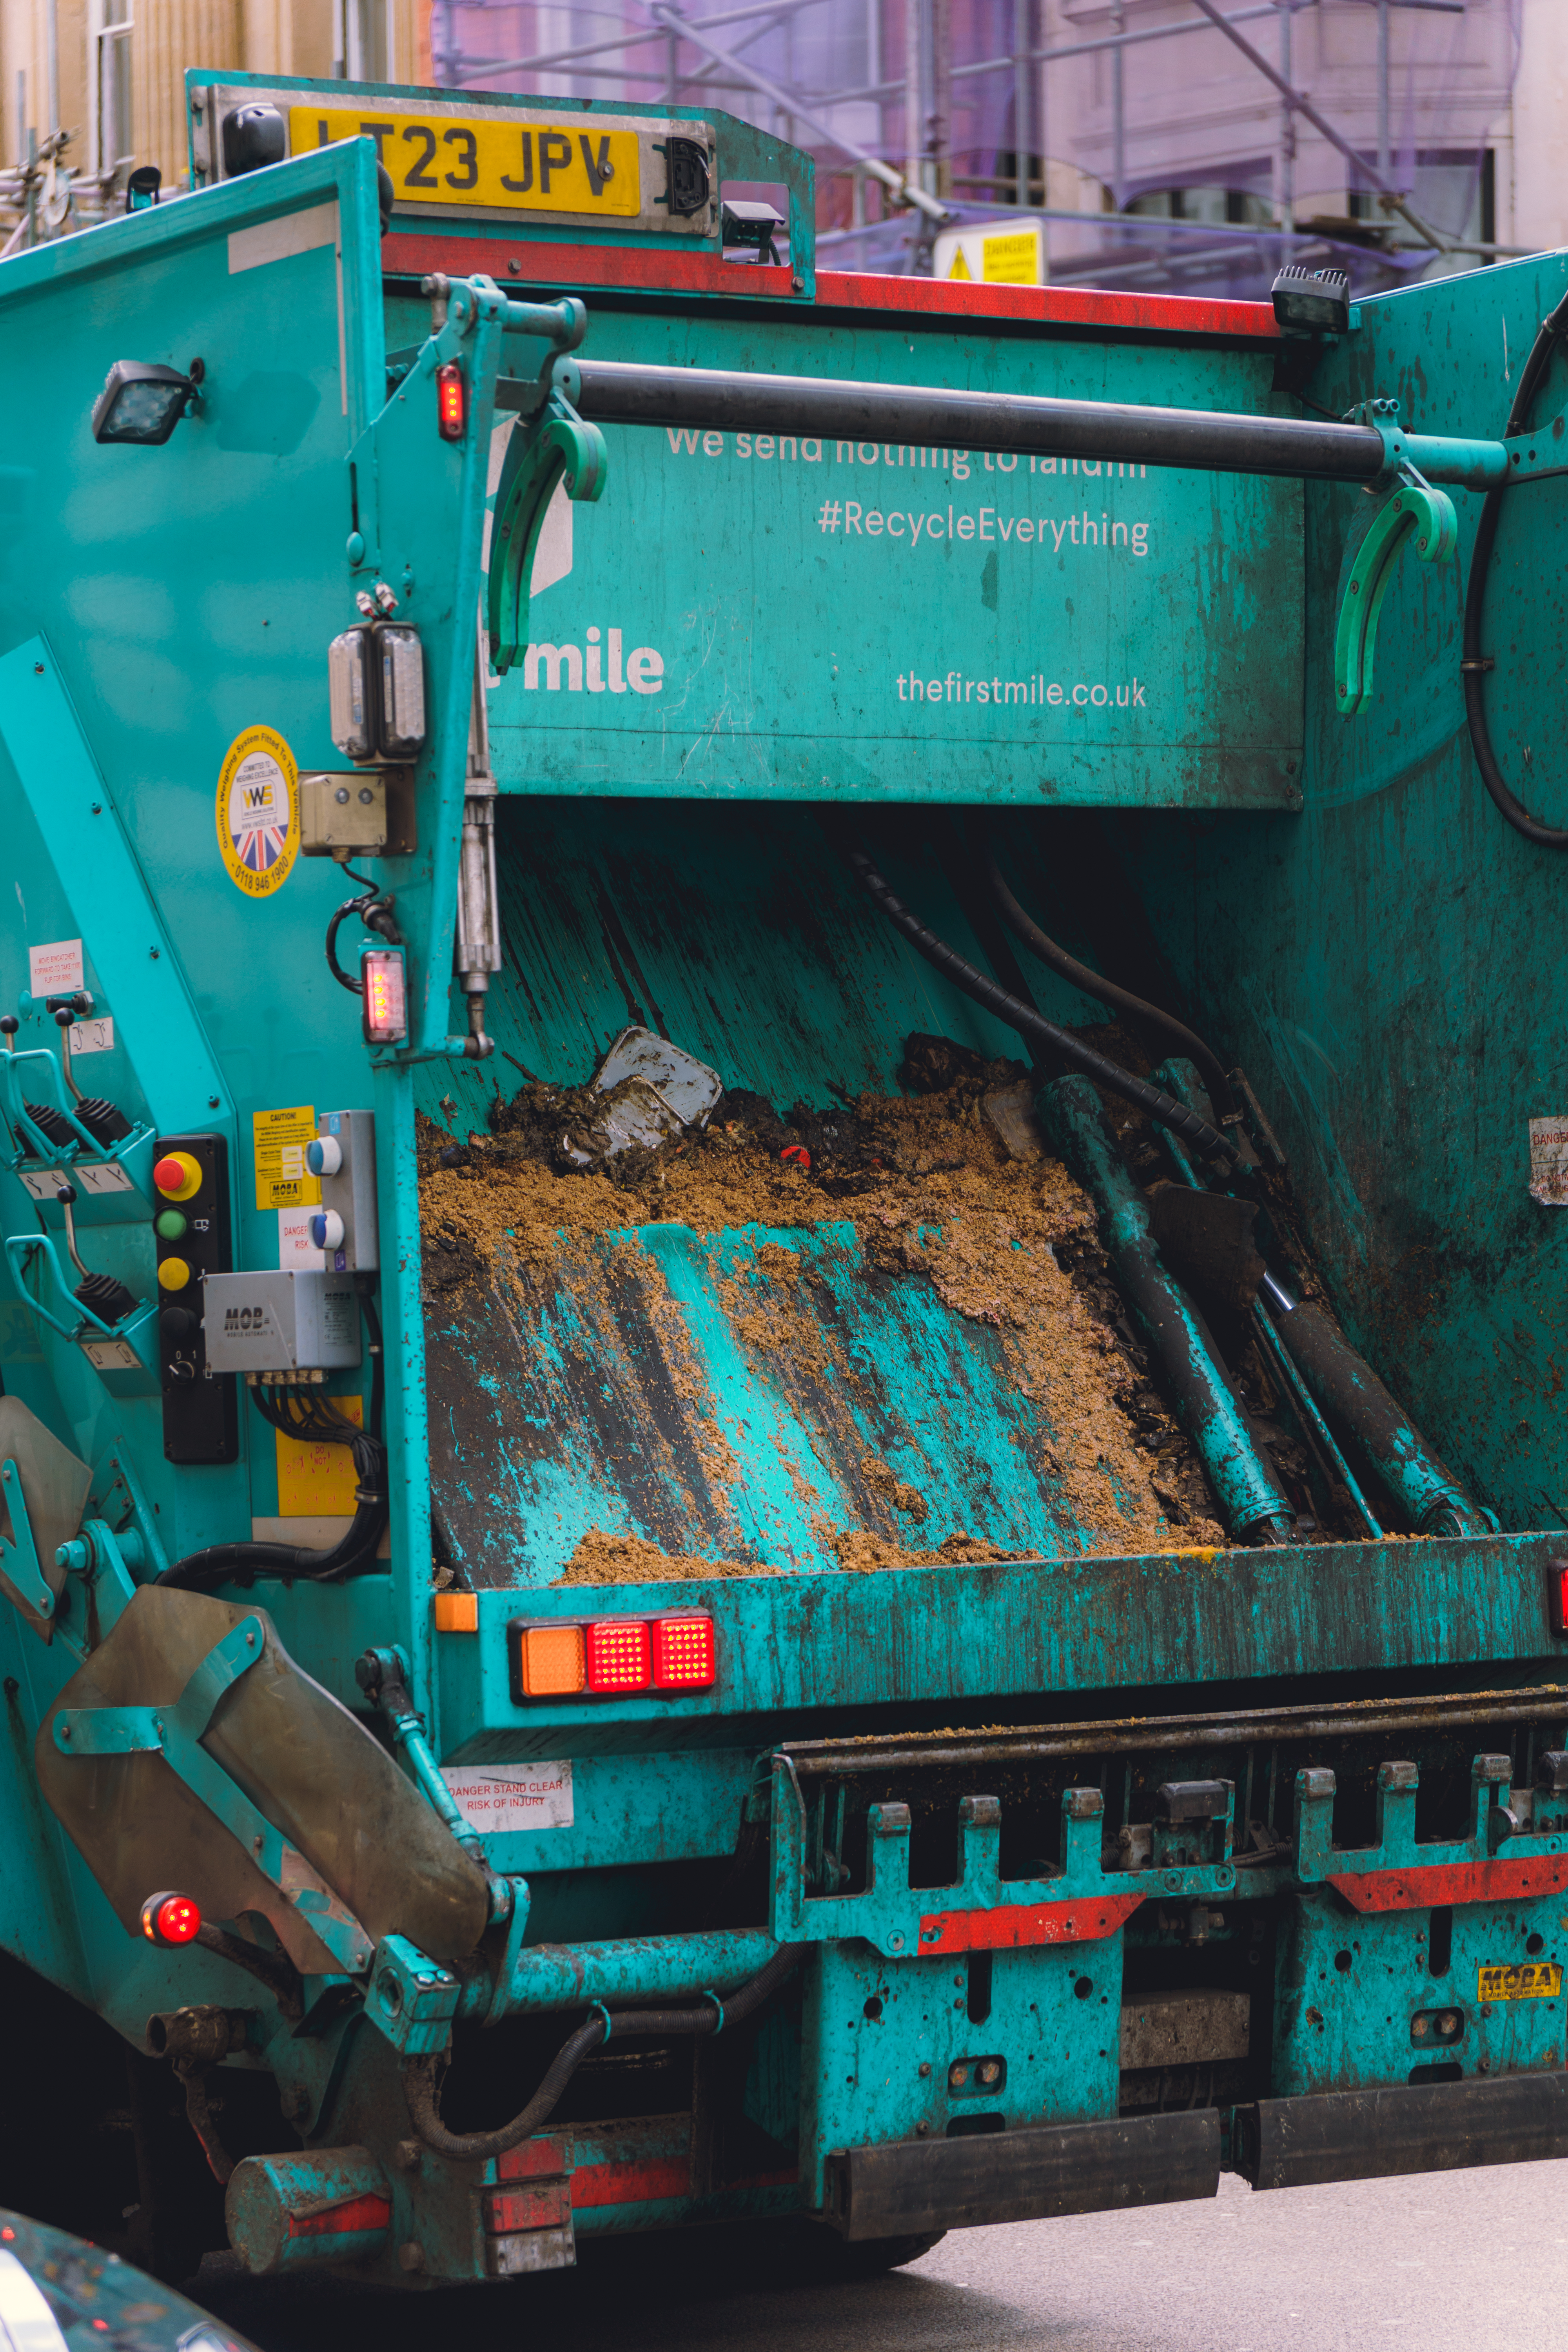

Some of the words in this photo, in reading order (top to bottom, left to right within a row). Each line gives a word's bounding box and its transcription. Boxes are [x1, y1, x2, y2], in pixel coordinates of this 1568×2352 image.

[501, 132, 610, 196] JPV
[666, 427, 724, 456] We
[736, 432, 822, 462] send
[818, 500, 1149, 556] #RecycleEverything
[524, 626, 664, 694] mile
[897, 671, 1146, 706] thefirstmile.co.uk
[220, 753, 238, 802] Weighing
[236, 735, 259, 753] System
[261, 732, 280, 750] Fitted
[280, 746, 287, 761] To
[243, 762, 264, 773] COMMITTED
[236, 773, 254, 783] WEIGHING
[255, 768, 278, 779] EXCELLENCE
[235, 865, 253, 889] 0118
[255, 875, 270, 891] 946
[271, 855, 289, 884] 1900
[34, 965, 54, 975] FORWARD
[270, 1112, 296, 1122] CAUTION!
[1533, 1132, 1568, 1145] DANGE
[272, 1183, 298, 1196] MOBA
[295, 1240, 309, 1249] RISK
[225, 1307, 270, 1330] MOB
[316, 1445, 325, 1454] DO
[314, 1456, 327, 1465] NOT
[449, 1785, 491, 1797] DANGER
[494, 1782, 526, 1794] STAND
[529, 1780, 563, 1793] CLEAR
[467, 1800, 491, 1810] RISK
[493, 1798, 506, 1809] OF
[510, 1797, 545, 1808] INJURY
